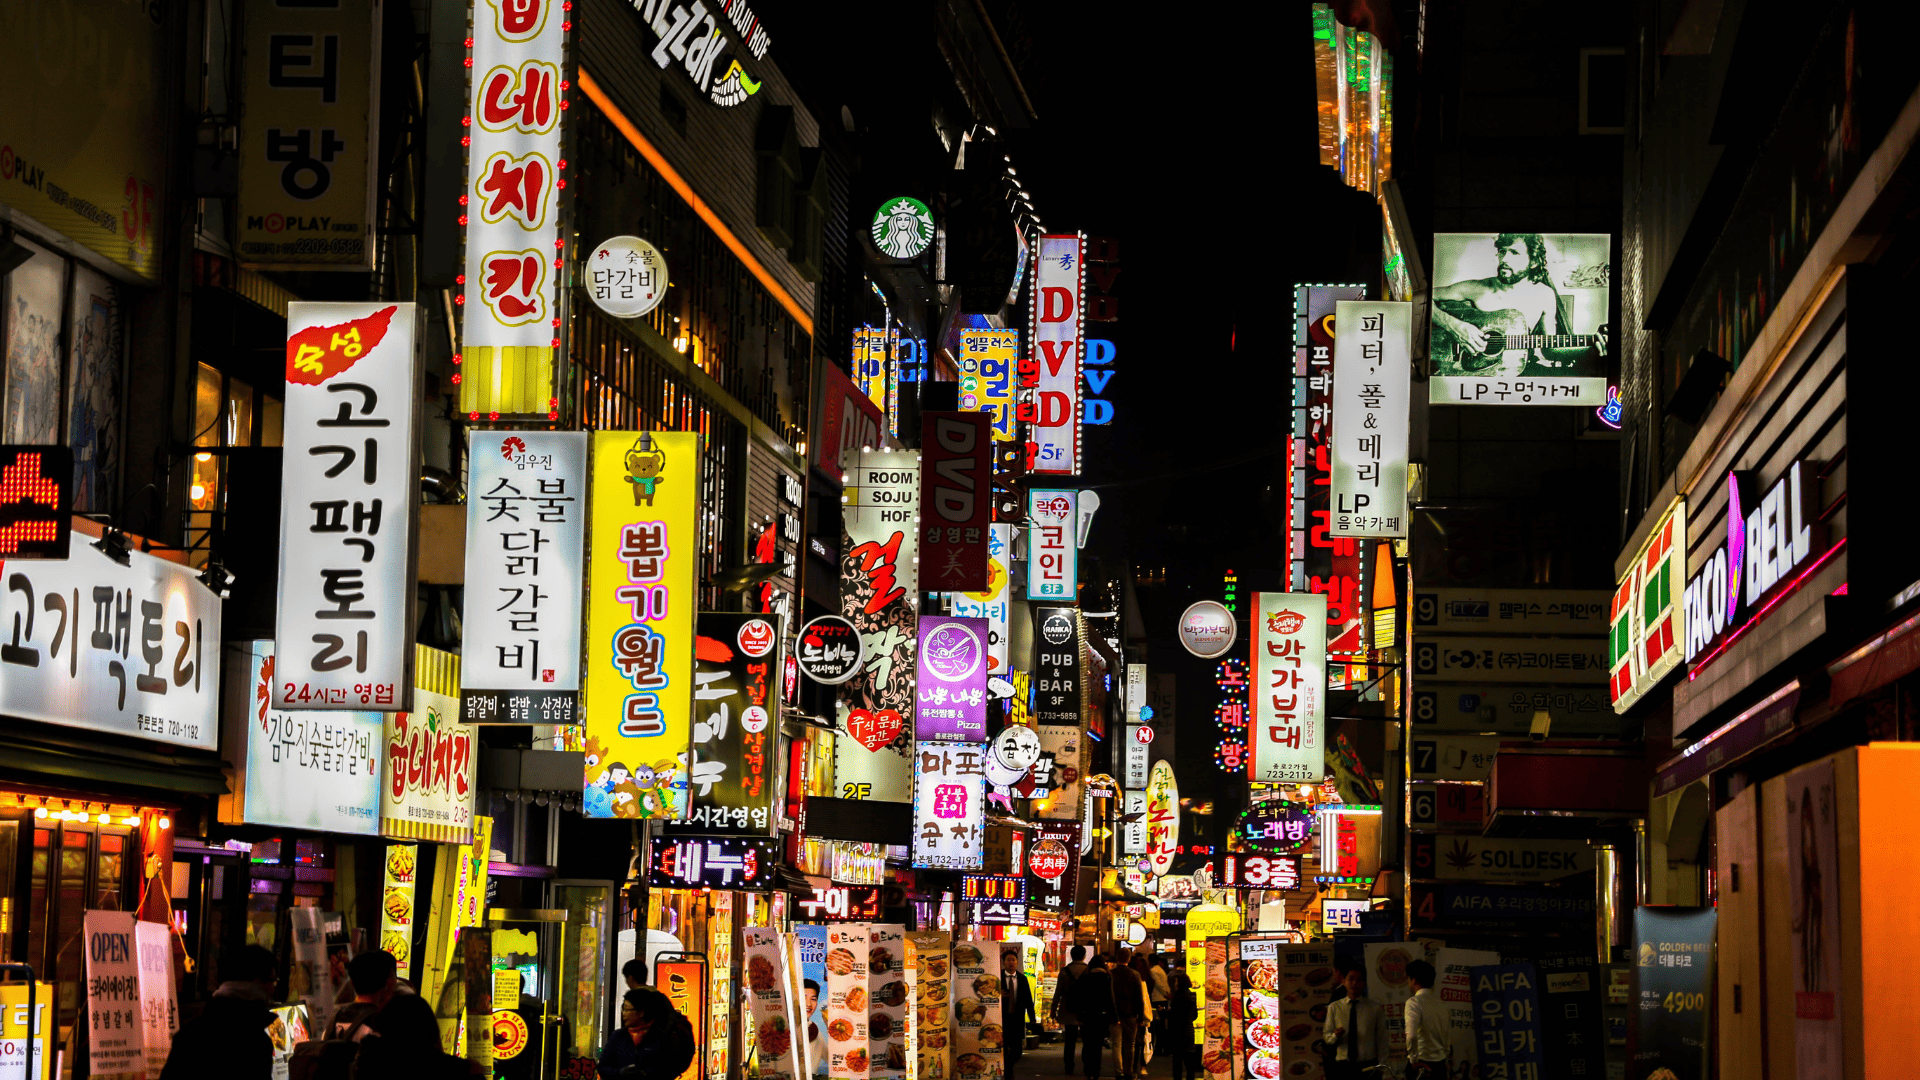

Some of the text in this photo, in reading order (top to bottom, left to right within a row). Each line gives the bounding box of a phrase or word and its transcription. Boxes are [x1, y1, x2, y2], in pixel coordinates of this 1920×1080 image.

[748, 23, 771, 61] HOF
[122, 174, 154, 247] 3F
[625, 249, 656, 265] 숯불
[592, 268, 657, 300] 닭갈비
[294, 326, 362, 375] 숙성
[965, 336, 1014, 353] 엠플러스
[1040, 286, 1075, 428] DVD
[1083, 339, 1117, 424] DVD
[1309, 346, 1332, 425] 프라하
[1459, 381, 1580, 402] LP 구멍가게
[513, 454, 553, 471] 김우진
[1041, 444, 1065, 461] 5F
[869, 472, 913, 484] ROOM
[934, 414, 976, 523] DVD
[480, 477, 576, 523] 숯불
[872, 491, 912, 503] SOJU
[1337, 493, 1370, 513] LP
[881, 510, 911, 522] HOF
[1036, 495, 1071, 522] 락휴
[308, 381, 391, 674] 고기팩토리
[1337, 516, 1400, 532] 음악카페
[927, 527, 981, 544] 상영관
[940, 547, 967, 578] 美
[1039, 525, 1065, 580] 코인
[1683, 460, 1811, 664] TACO BELL
[1045, 584, 1062, 594] 3F
[495, 528, 550, 682] 닭갈비
[955, 602, 1006, 623] 노가리
[1418, 598, 1436, 622] 9
[1499, 603, 1543, 619] 펠리스
[1546, 603, 1603, 619] 스페인어
[614, 520, 669, 738] 뽑기월드
[1184, 625, 1230, 636] 박가부대
[1, 570, 203, 712] 고기팩토리
[1041, 653, 1073, 666] PUB
[1417, 646, 1435, 671] 8
[1053, 668, 1060, 677] &
[283, 682, 394, 704] 24시간 영업
[1040, 680, 1073, 692] BAR
[1266, 638, 1306, 750] 박가부대
[466, 695, 573, 721] 닭갈비 닭발 삼겹살
[1051, 696, 1065, 705] 3F
[1417, 695, 1435, 720] 8
[956, 720, 981, 730] Pizza
[1037, 711, 1078, 720] T.733-5858
[1219, 664, 1244, 767] 노래방
[168, 719, 198, 740] 720-1192
[866, 731, 890, 748] 공간
[269, 714, 373, 777] 김우진숯불닭갈비
[389, 711, 471, 797] 굽네치킨
[921, 751, 981, 775] 마포
[1415, 746, 1434, 769] 7
[1266, 770, 1313, 780] 723-2112
[843, 783, 871, 800] 2F
[1090, 788, 1113, 797] KIRIN
[936, 801, 964, 818] 구이
[1415, 795, 1433, 819] 6
[920, 822, 979, 848] 곱창
[1037, 831, 1071, 842] Luxury
[1246, 820, 1306, 841] 노래방
[918, 854, 978, 865] 본점 732-1197
[1030, 856, 1067, 870] 羊肉串
[1415, 844, 1578, 870] 5 SOLDESK
[1244, 857, 1297, 888] 3층
[966, 878, 1015, 898] DVD
[1417, 891, 1437, 922] 4
[1452, 895, 1493, 909] AIFA
[91, 932, 130, 962] OPEN
[1257, 944, 1278, 953] 고기
[1659, 942, 1692, 952] GOLDEN
[1309, 952, 1329, 964] 메뉴
[1567, 956, 1593, 967] 유학원
[1659, 954, 1692, 968] 더블타코
[1476, 971, 1532, 993] AIFA
[1662, 991, 1704, 1014] 4900
